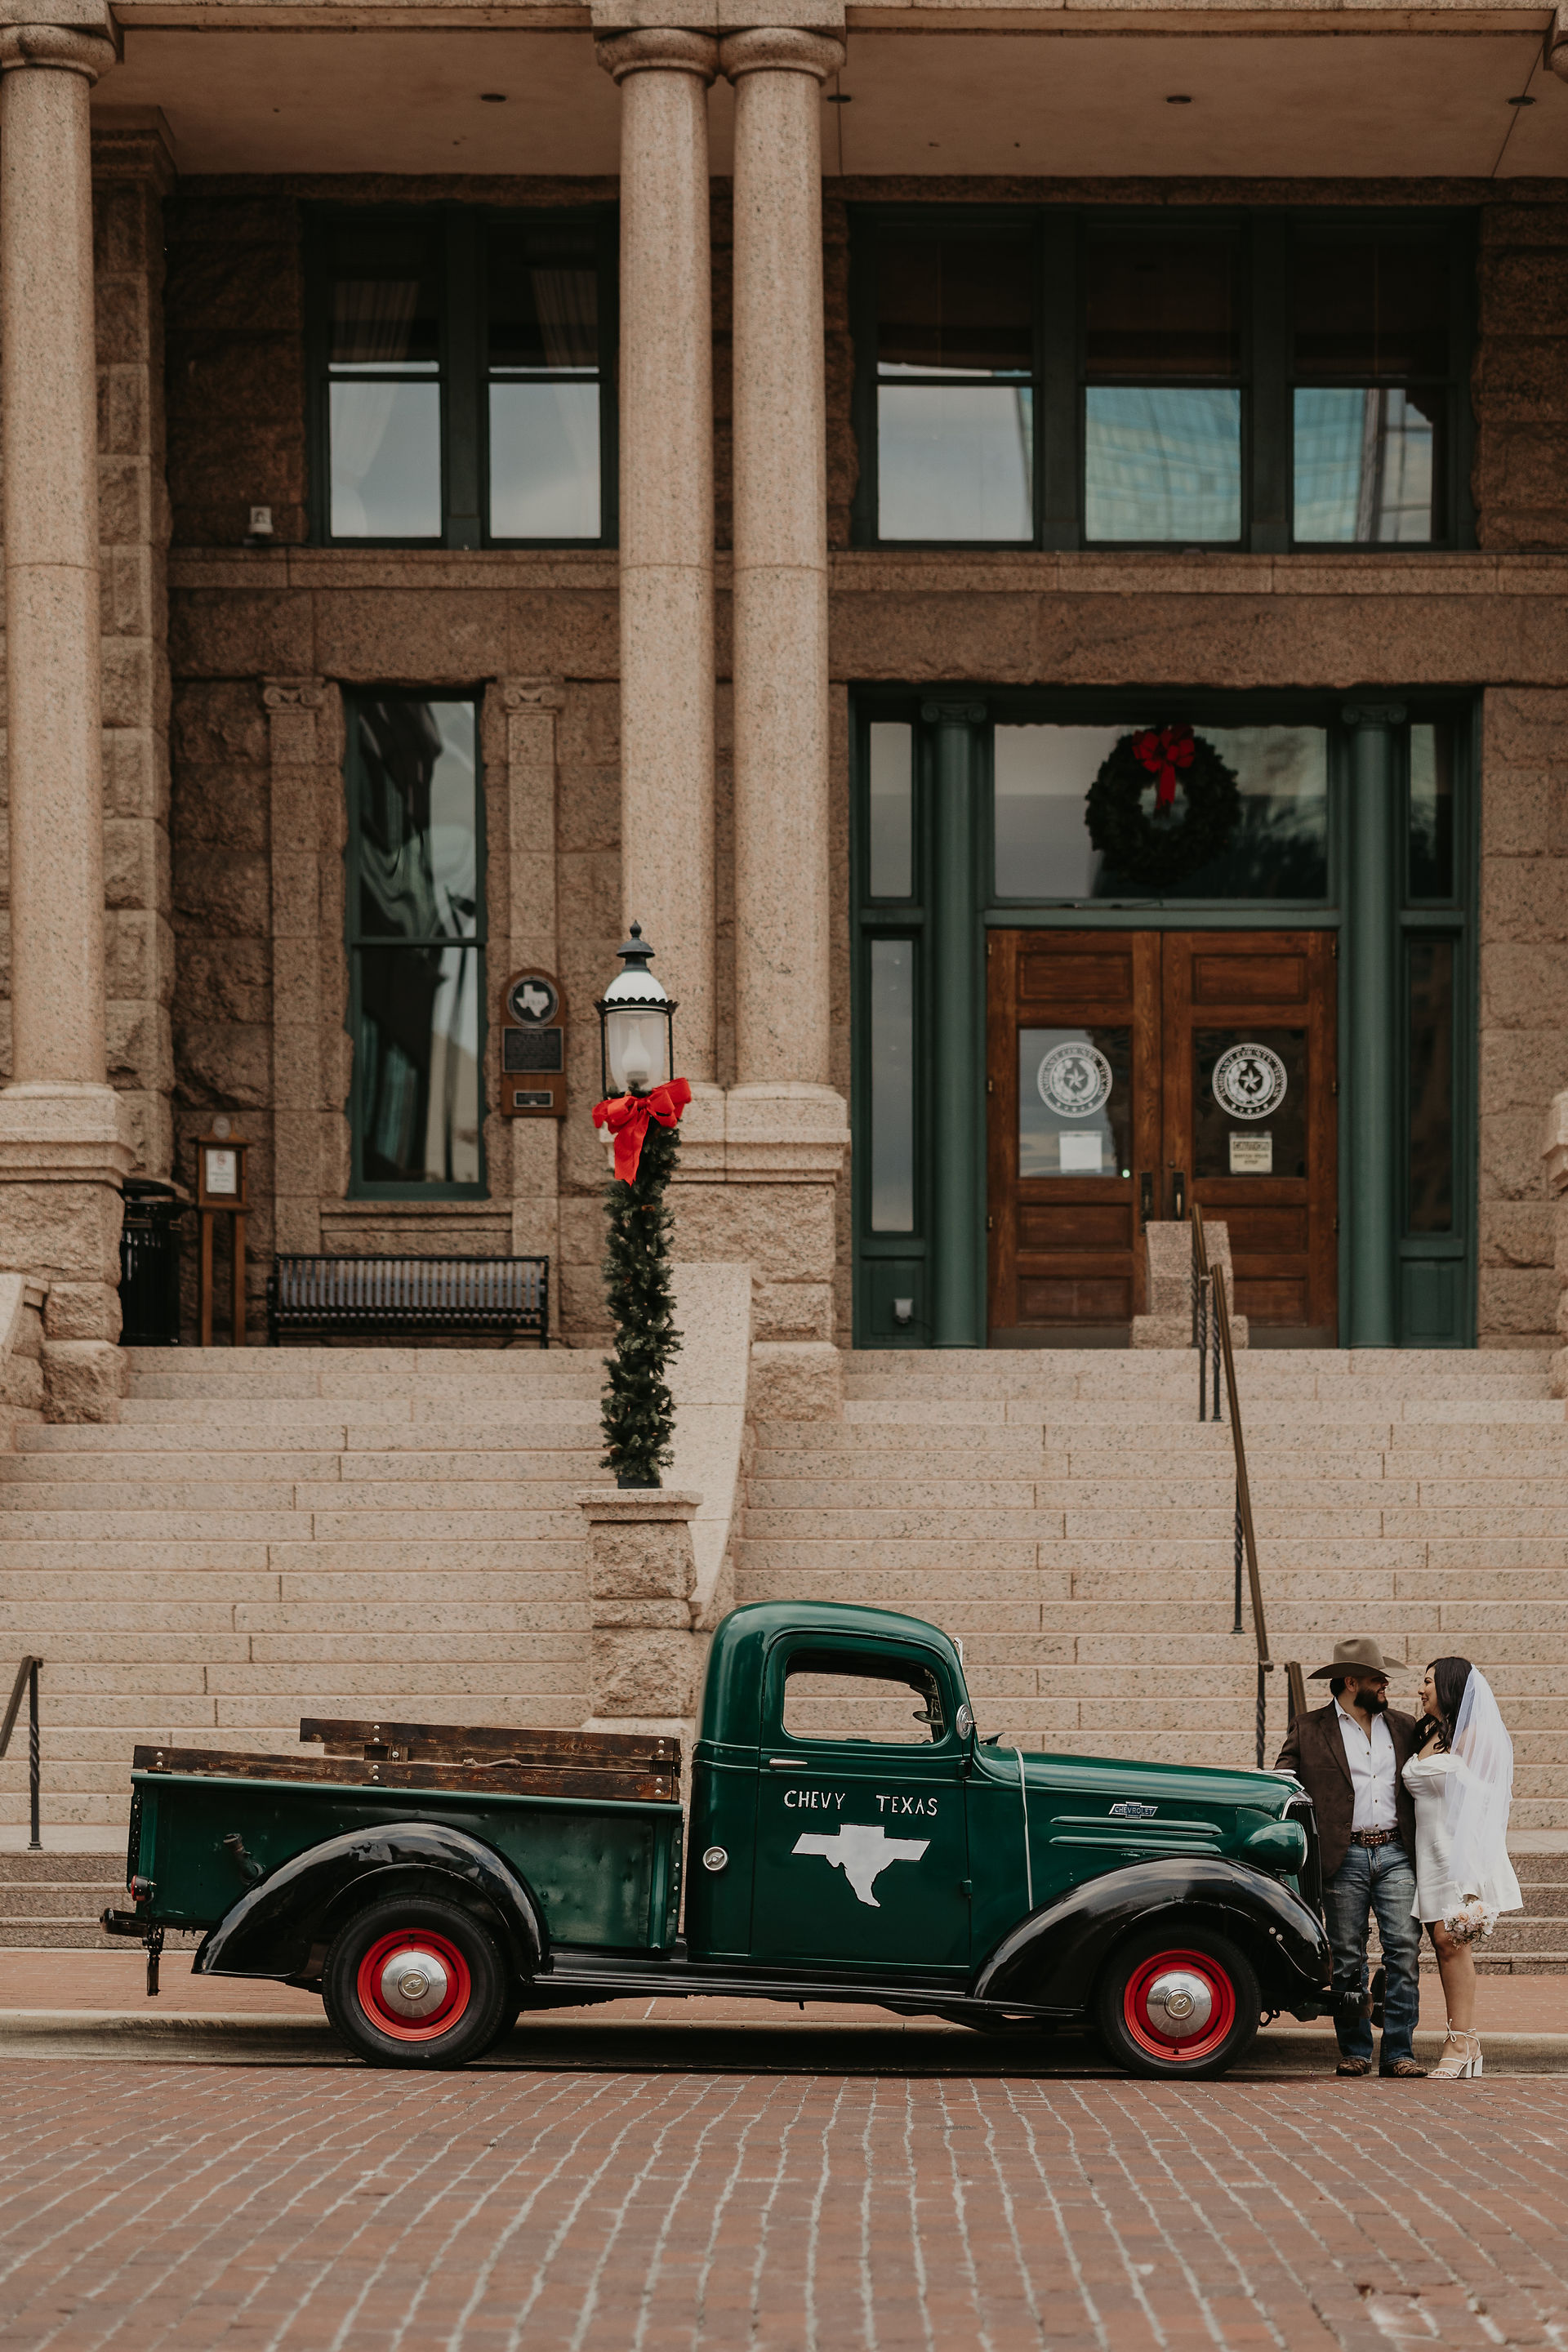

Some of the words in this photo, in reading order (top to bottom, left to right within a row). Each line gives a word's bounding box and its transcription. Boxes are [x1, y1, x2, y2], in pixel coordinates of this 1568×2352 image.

[783, 1789, 846, 1810] CHEVY
[875, 1794, 938, 1816] TEXAS
[1114, 1806, 1153, 1815] CHEVROLET
